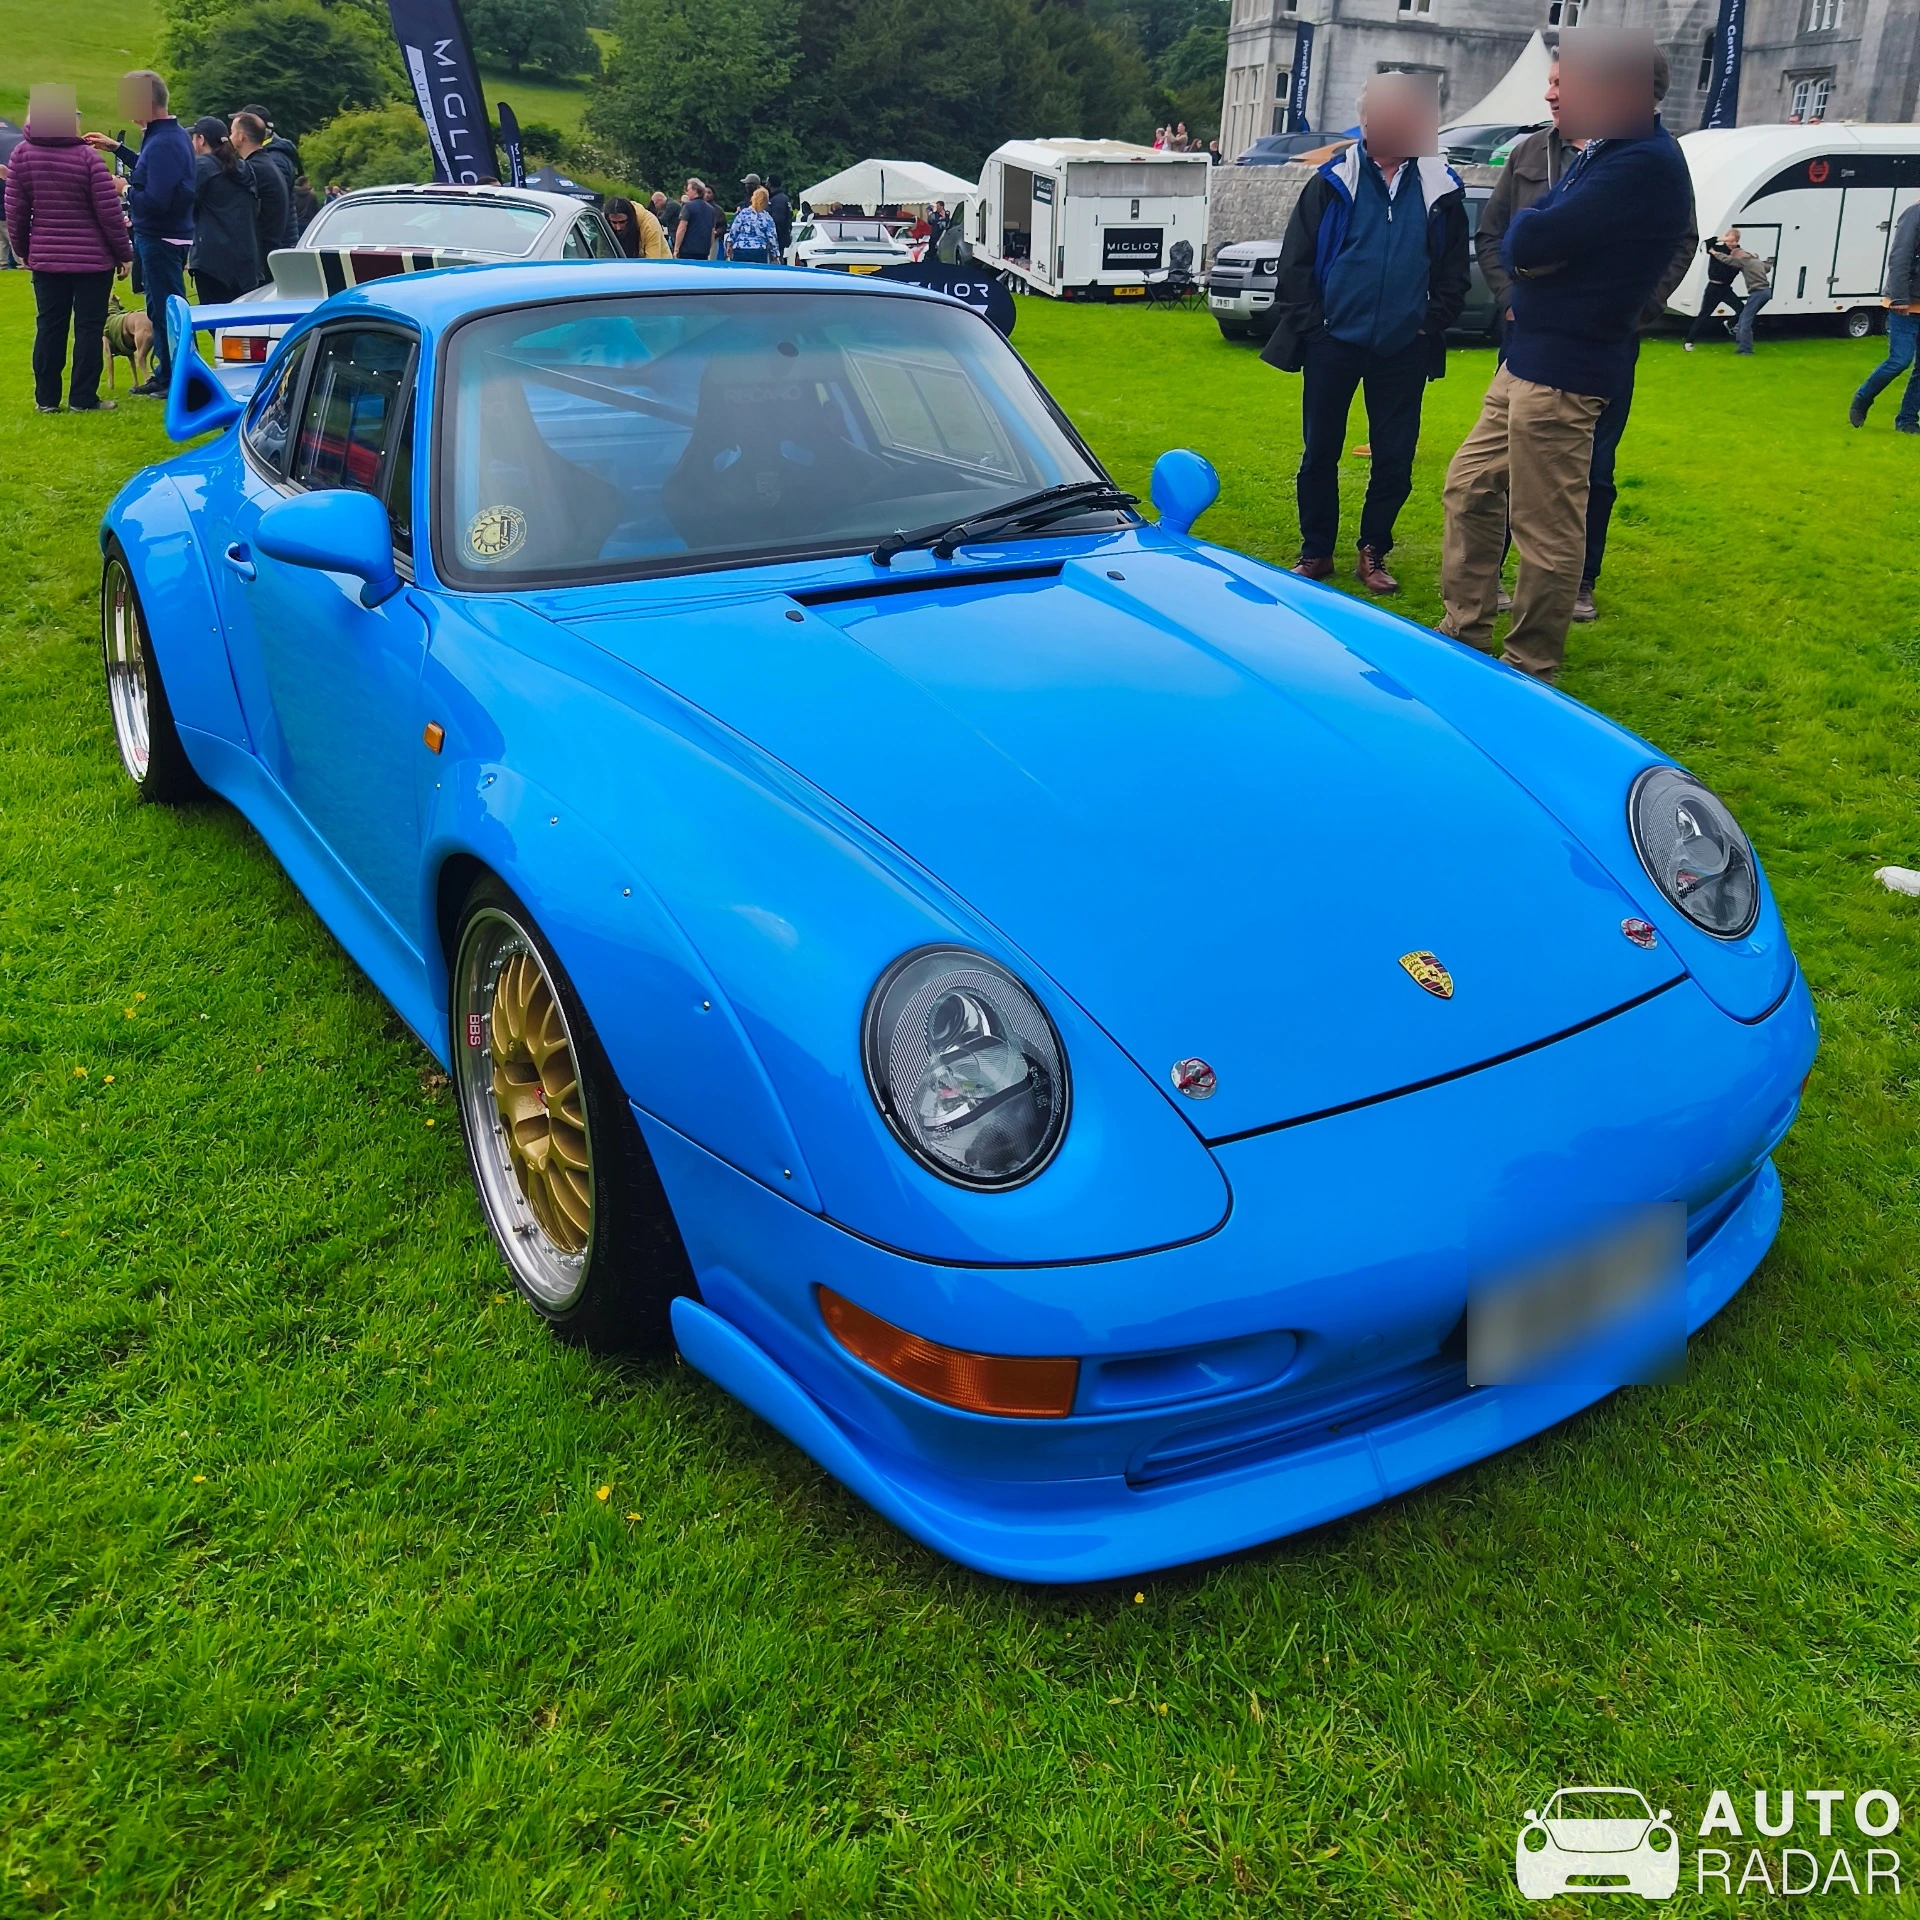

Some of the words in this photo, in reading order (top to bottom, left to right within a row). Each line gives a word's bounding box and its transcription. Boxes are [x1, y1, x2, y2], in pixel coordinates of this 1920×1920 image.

[1300, 40, 1310, 77] Porsche
[1725, 25, 1736, 74] Centre
[1296, 79, 1307, 109] Centre
[1107, 242, 1159, 250] MIGLIOR
[470, 1015, 481, 1046] BBS
